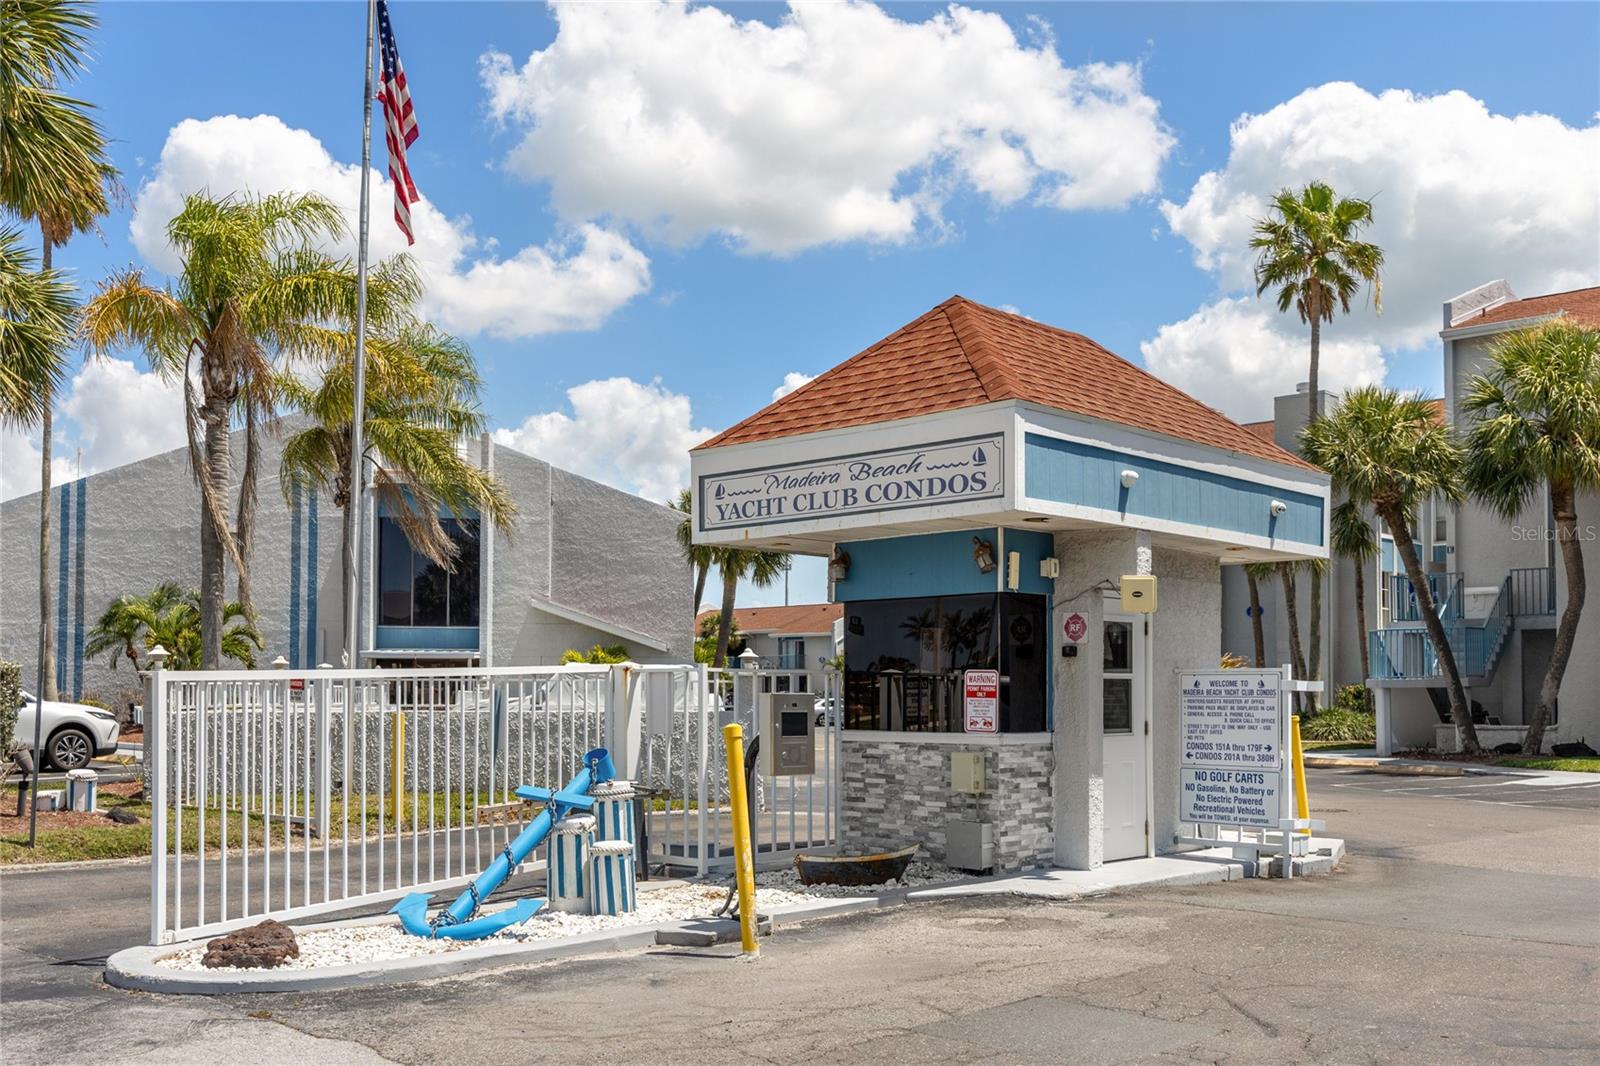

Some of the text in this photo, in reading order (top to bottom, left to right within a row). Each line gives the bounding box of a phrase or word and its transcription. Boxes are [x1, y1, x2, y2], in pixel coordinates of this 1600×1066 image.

[764, 454, 926, 494] Madeira Beach
[715, 470, 988, 522] YACHT CLUB CONDOS
[968, 675, 995, 683] WARNING
[1186, 742, 1213, 750] CONDOS
[1195, 752, 1222, 760] CONDOS
[1224, 753, 1240, 761] 201A
[1257, 754, 1274, 762] 380H
[1195, 771, 1264, 784] NO GOLF CARTS
[1197, 784, 1227, 794] Gasoline,
[1240, 786, 1265, 796] Battery
[1207, 795, 1232, 804] Electric
[1233, 796, 1263, 805] Powered
[1193, 803, 1265, 816] Recreational Vehicles
